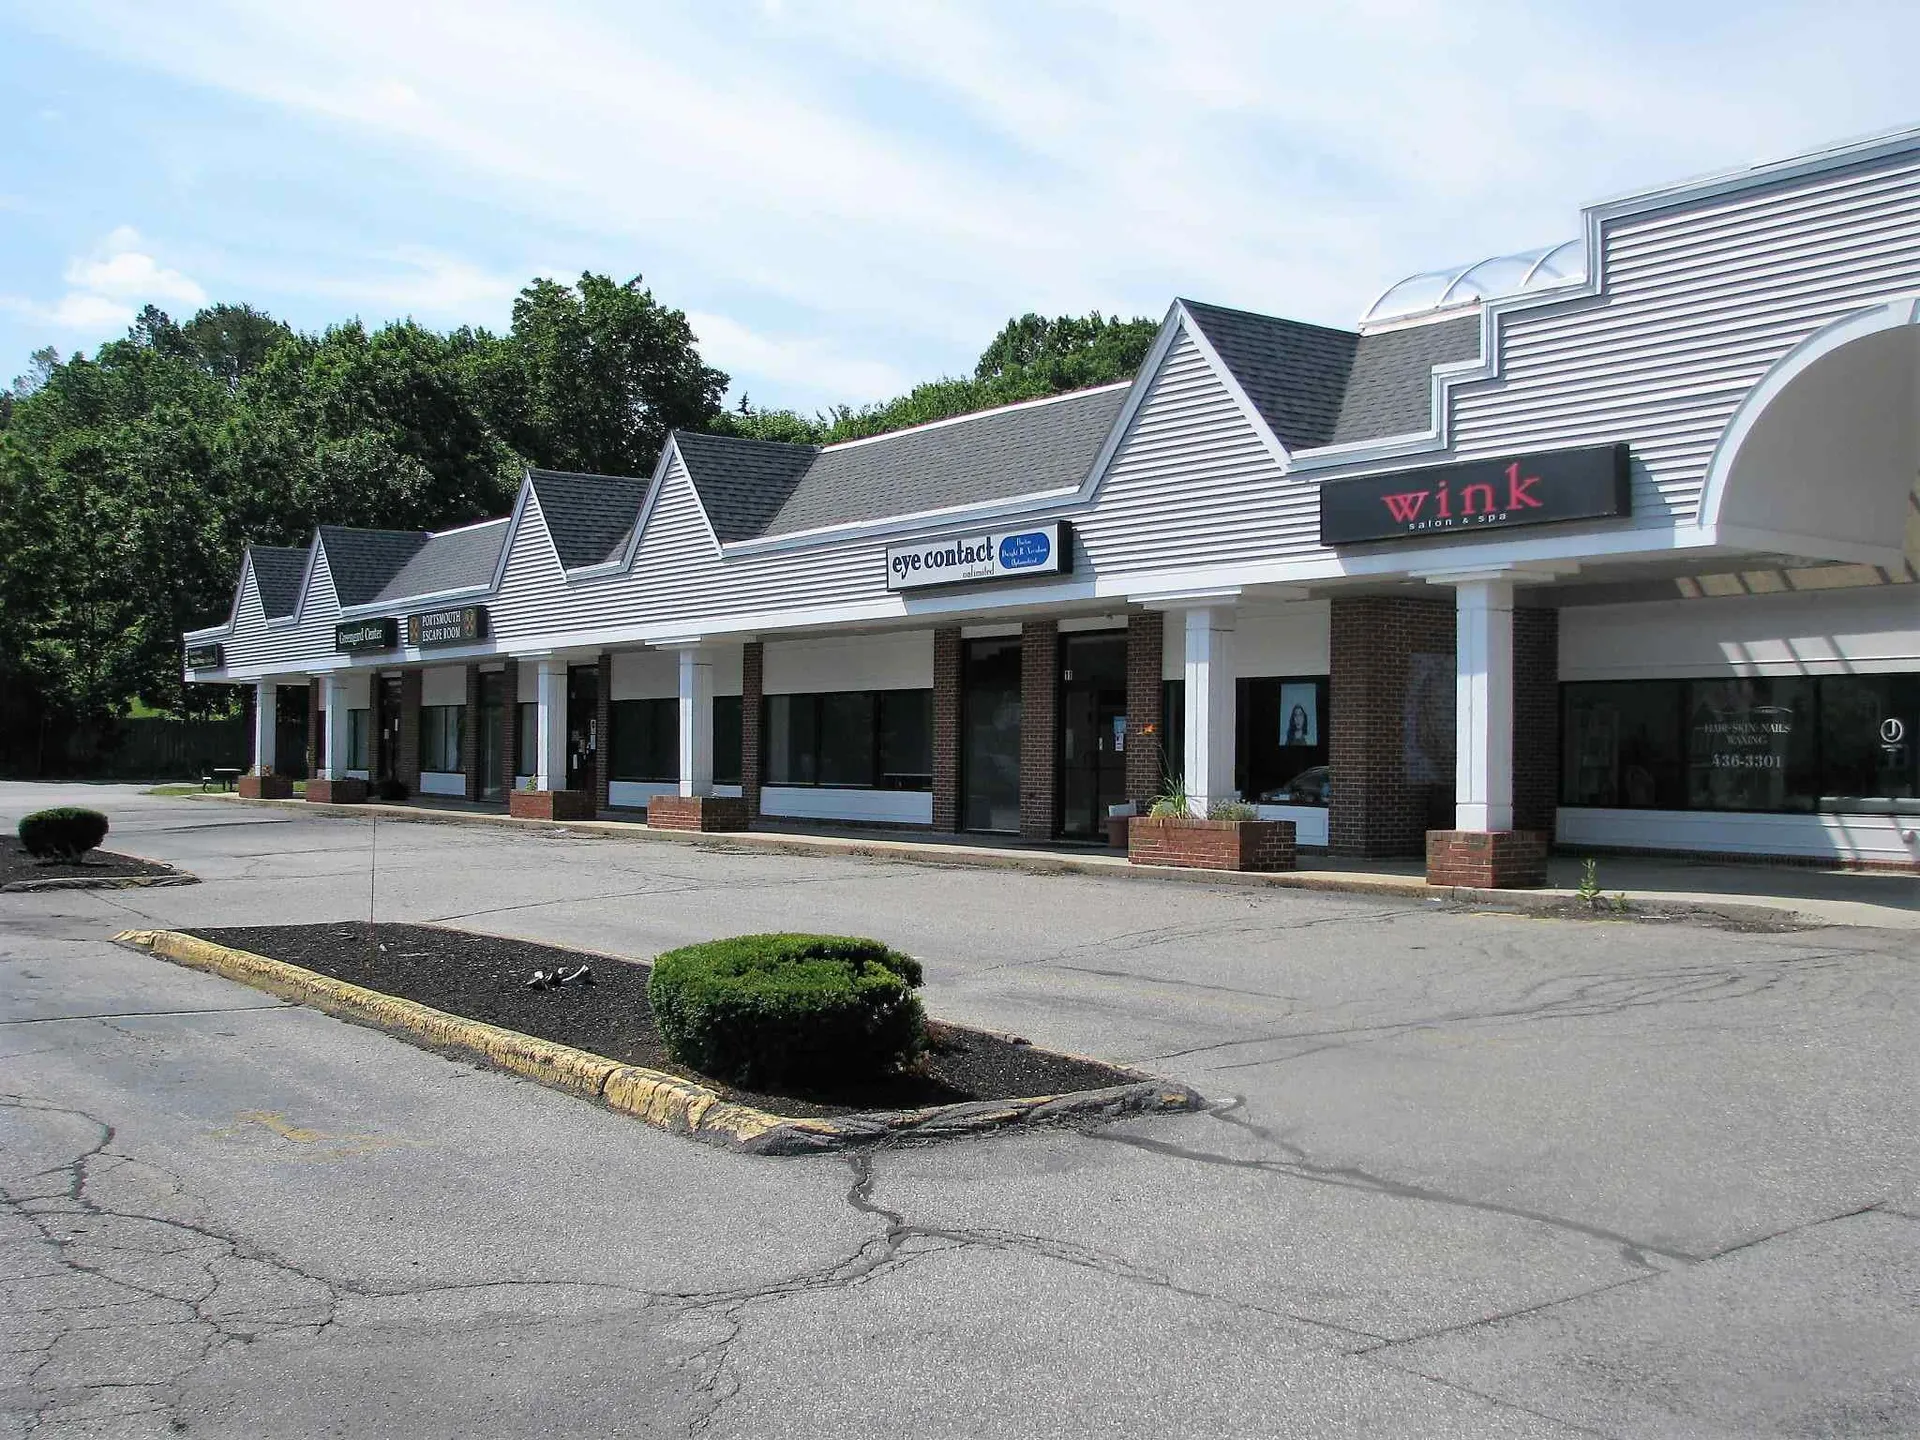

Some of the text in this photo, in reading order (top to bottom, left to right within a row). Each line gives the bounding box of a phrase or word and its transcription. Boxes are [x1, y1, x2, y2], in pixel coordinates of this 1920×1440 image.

[1380, 462, 1544, 524] wink
[1408, 512, 1508, 531] salon & spa
[892, 553, 922, 580] eye
[924, 536, 994, 569] contact
[422, 610, 461, 627] PORTSMOUTH
[422, 626, 461, 642] ESCAPE ROOM
[1712, 753, 1781, 768] 436-3301
